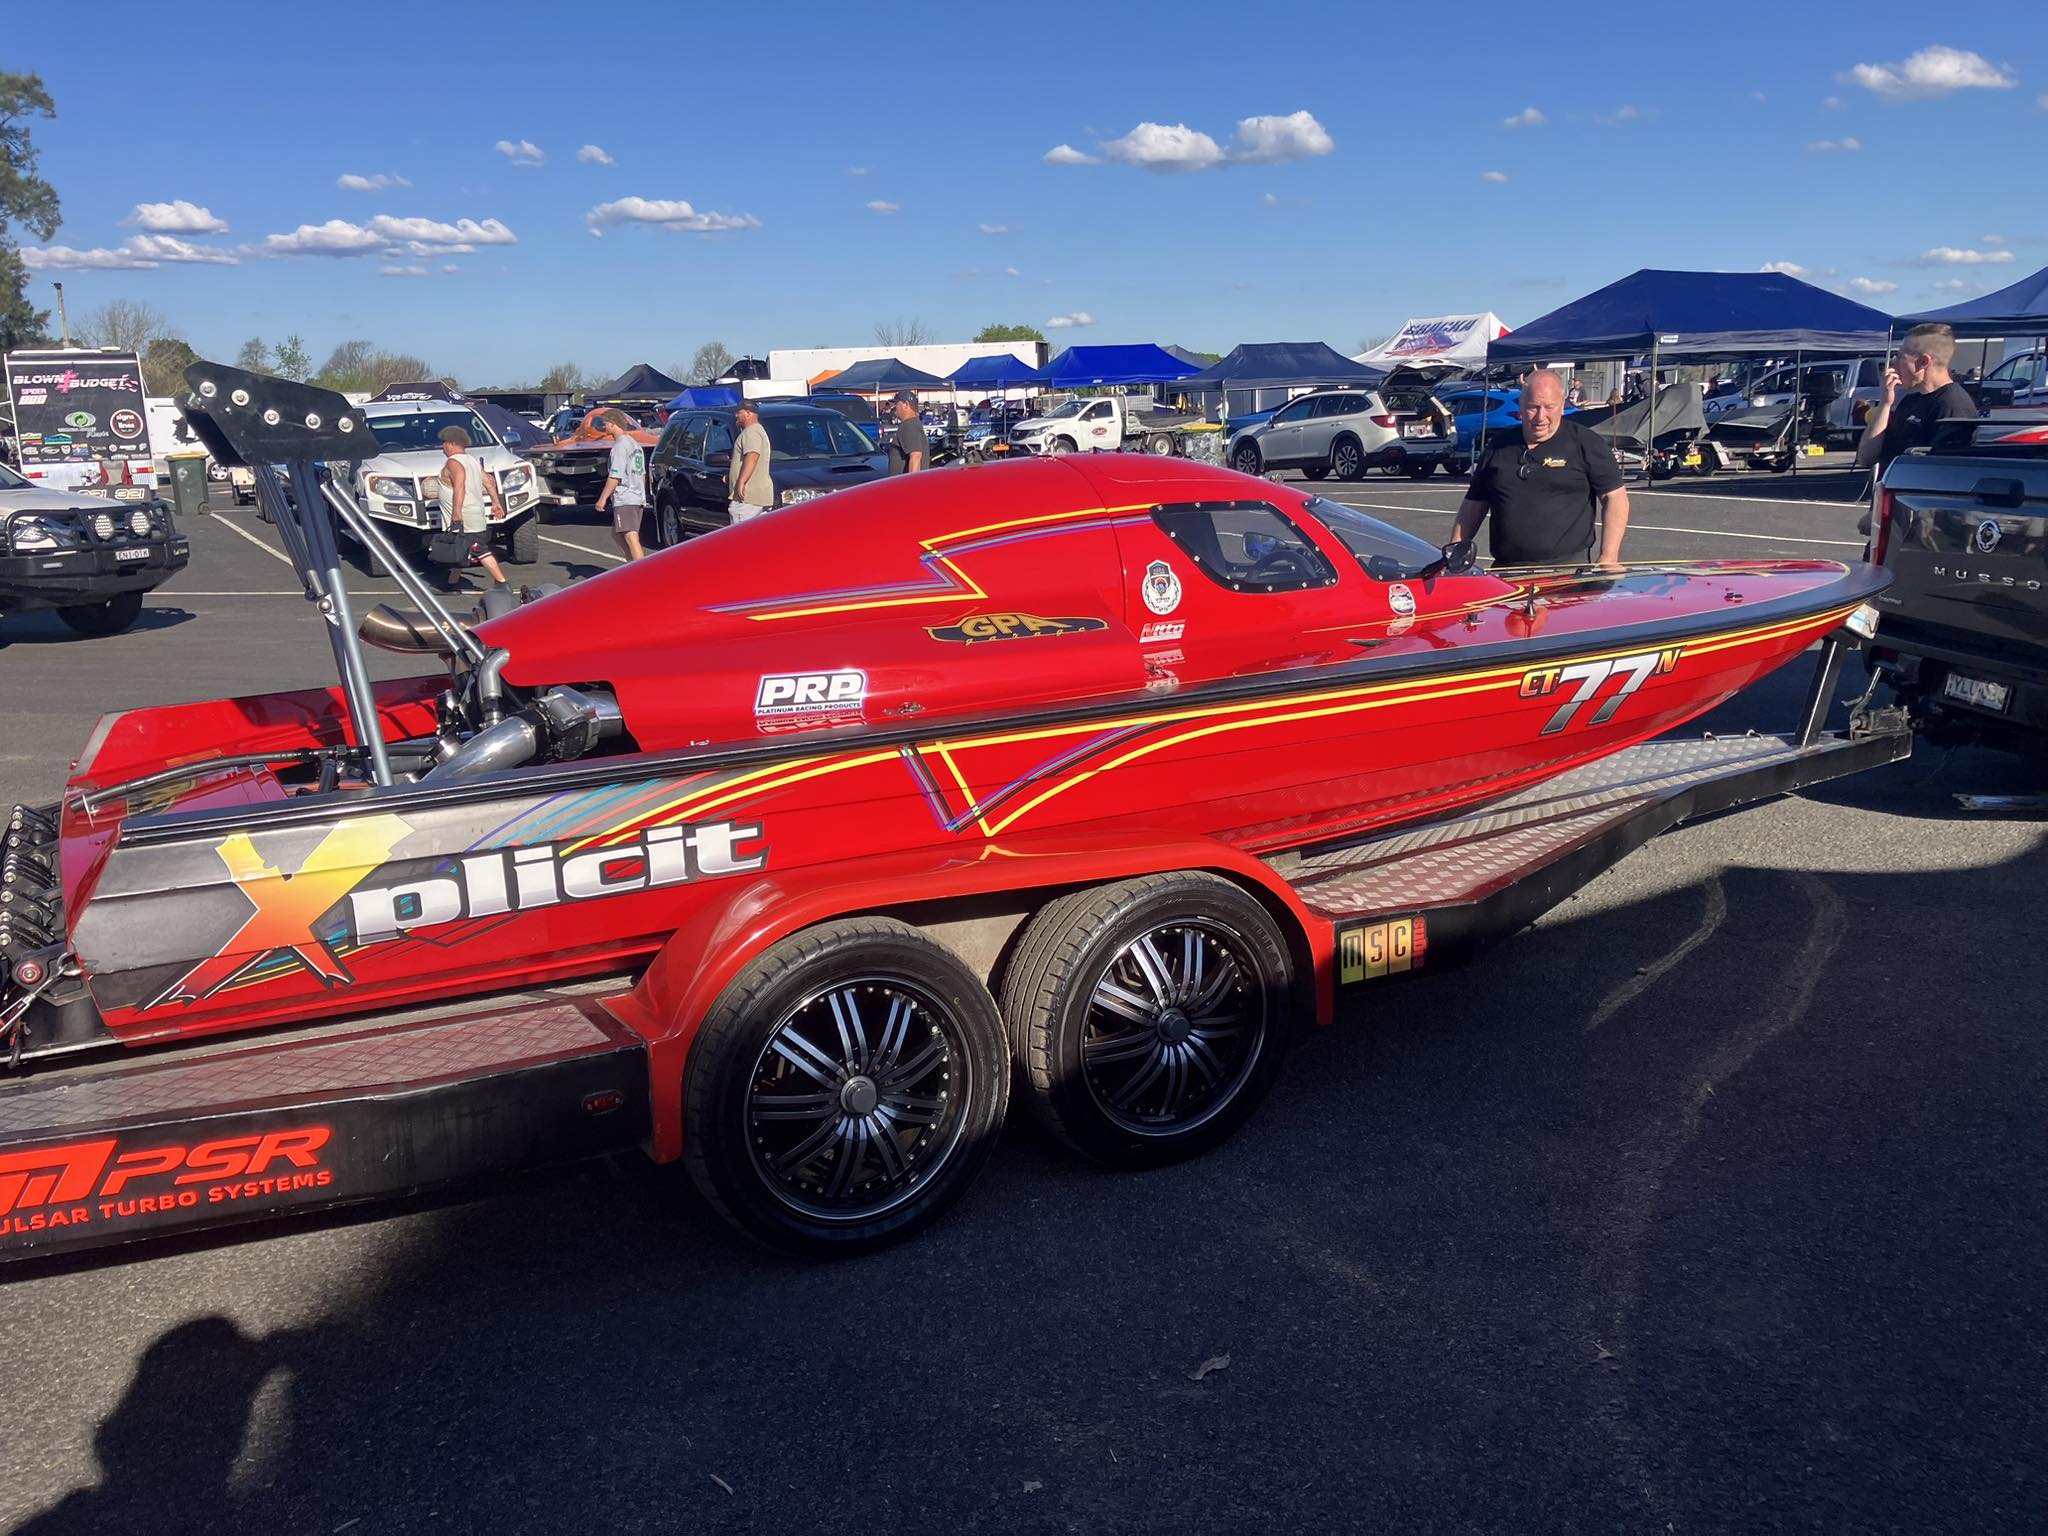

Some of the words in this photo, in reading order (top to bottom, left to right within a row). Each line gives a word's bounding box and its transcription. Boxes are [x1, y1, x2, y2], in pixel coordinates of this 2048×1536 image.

[13, 375, 65, 384] BLOWN
[1934, 566, 2041, 589] MUSSO
[961, 615, 1072, 637] GPA
[965, 626, 1086, 646] garage
[760, 674, 863, 706] PRP
[1541, 652, 1661, 736] 77
[757, 706, 794, 715] PLATINUM
[796, 703, 823, 712] RACING
[825, 701, 862, 710] PRODUCTS
[142, 812, 772, 1012] Xplicit
[98, 1191, 199, 1220] TURBO
[208, 1171, 332, 1203] SYSTEMS
